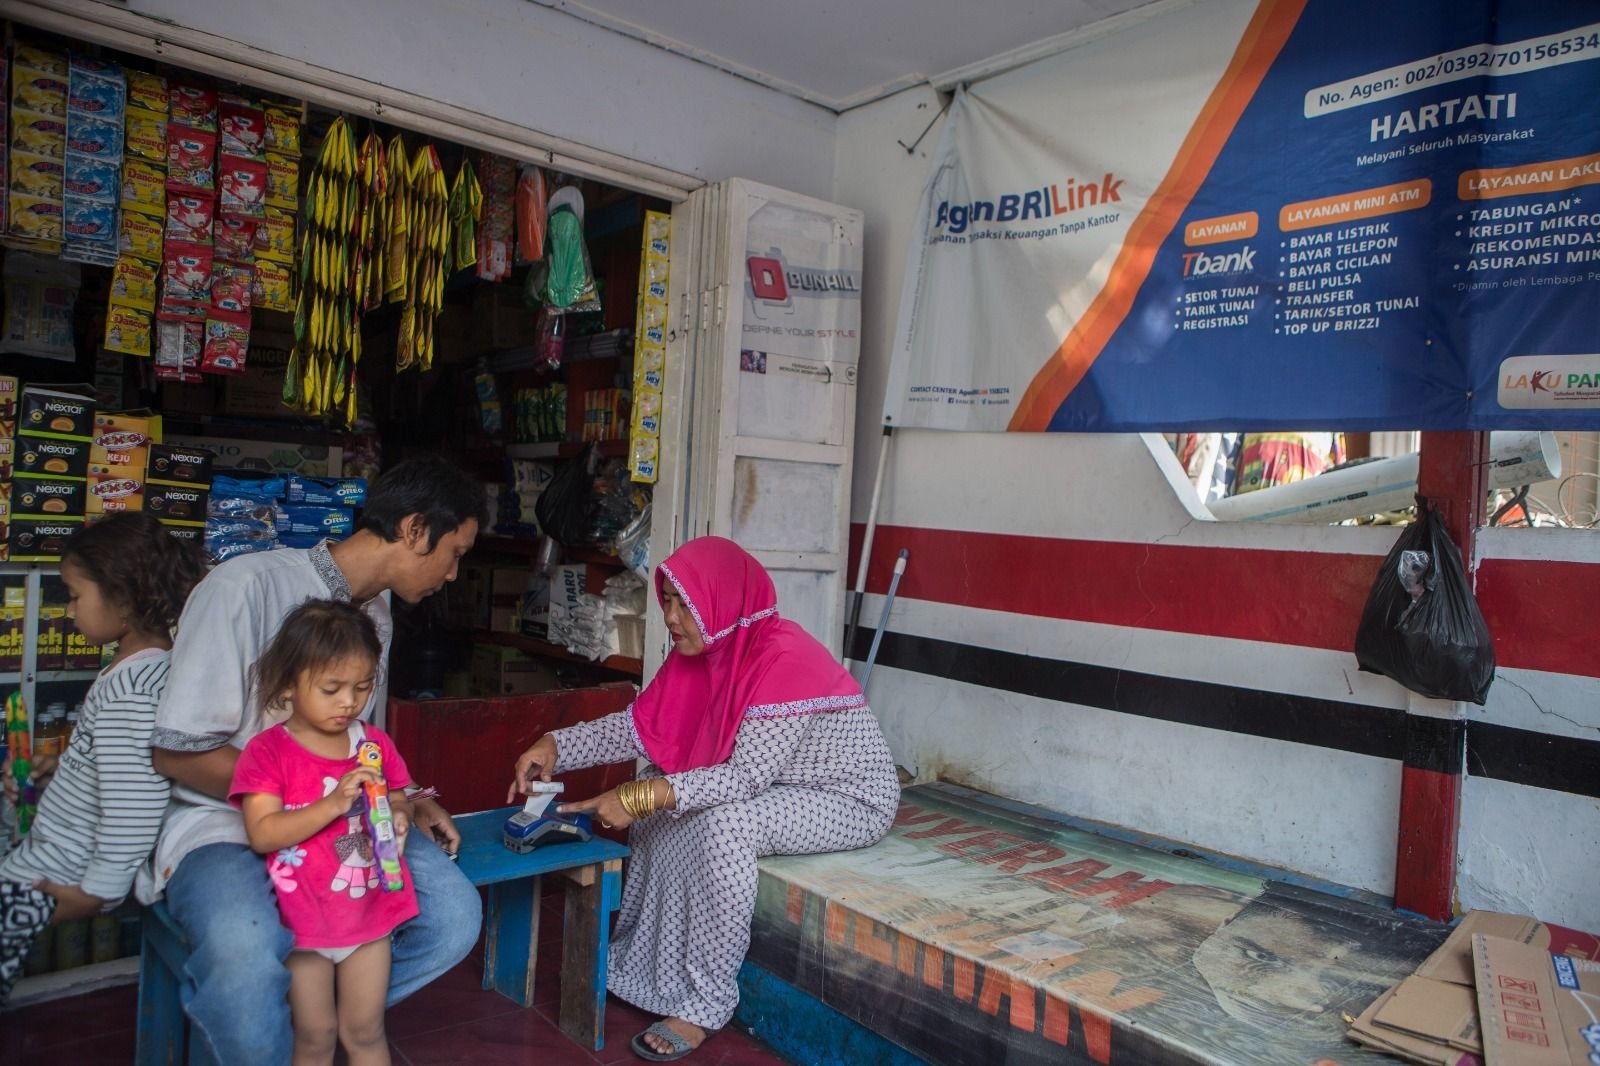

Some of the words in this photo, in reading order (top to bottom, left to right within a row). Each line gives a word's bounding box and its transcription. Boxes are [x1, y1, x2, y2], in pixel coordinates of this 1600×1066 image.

[1319, 93, 1345, 107] No.
[1350, 76, 1399, 99] Agen:
[1370, 93, 1517, 142] HARTATI
[1356, 146, 1405, 167] Melayani
[1409, 137, 1453, 155] Seluruh
[1457, 128, 1535, 146] Masyarakat
[1469, 170, 1553, 191] LAYANAN
[1288, 202, 1350, 223] LAYANAN
[1353, 195, 1386, 211] MINI
[1388, 188, 1420, 204] ATM
[124, 218, 161, 235] Dancow
[1004, 227, 1057, 240] Keuangan
[1060, 221, 1085, 235] Tanpa
[1087, 213, 1120, 227] Kantor
[1192, 220, 1247, 239] LAYANAN
[1290, 232, 1333, 248] BAYAR
[1337, 222, 1389, 241] LISTRIK
[1469, 221, 1534, 239] KREDIT
[1290, 247, 1331, 263] BAYAR
[1336, 236, 1398, 256] TELEPON
[1182, 246, 1257, 278] Tbank
[1289, 262, 1331, 278] BAYAR
[1335, 253, 1391, 270] CICILAN
[1466, 251, 1559, 272] ASURANSI
[119, 263, 154, 281] Dancow
[787, 271, 860, 292] DUNHILL
[1502, 277, 1526, 288] oleh
[1531, 274, 1583, 286] Lembaga
[1287, 279, 1316, 293] BELI
[1320, 273, 1361, 288] PULSA
[1185, 290, 1218, 304] SETOR
[1221, 285, 1260, 299] TUNAI
[1286, 290, 1354, 306] TRANSFER
[1185, 305, 1217, 317] TARIK
[1219, 300, 1255, 313] TUNAI
[1284, 302, 1371, 321] TARIK/SETOR
[1376, 296, 1419, 314] TUNAI
[114, 314, 148, 330] Dancow
[742, 324, 783, 336] DEFINE
[784, 326, 815, 337] YOUR
[816, 329, 857, 338] STYLE
[1183, 315, 1249, 331] REGISTRASI
[1284, 323, 1308, 335] TOP
[1312, 321, 1330, 333] UP
[1334, 317, 1380, 331] BRIZZI
[1504, 370, 1562, 394] LAKU
[107, 453, 131, 463] KEJU
[336, 488, 364, 496] OREO
[102, 501, 126, 511] KEJU
[323, 517, 350, 525] OREO
[563, 570, 577, 602] BARU
[67, 645, 101, 656] kotak
